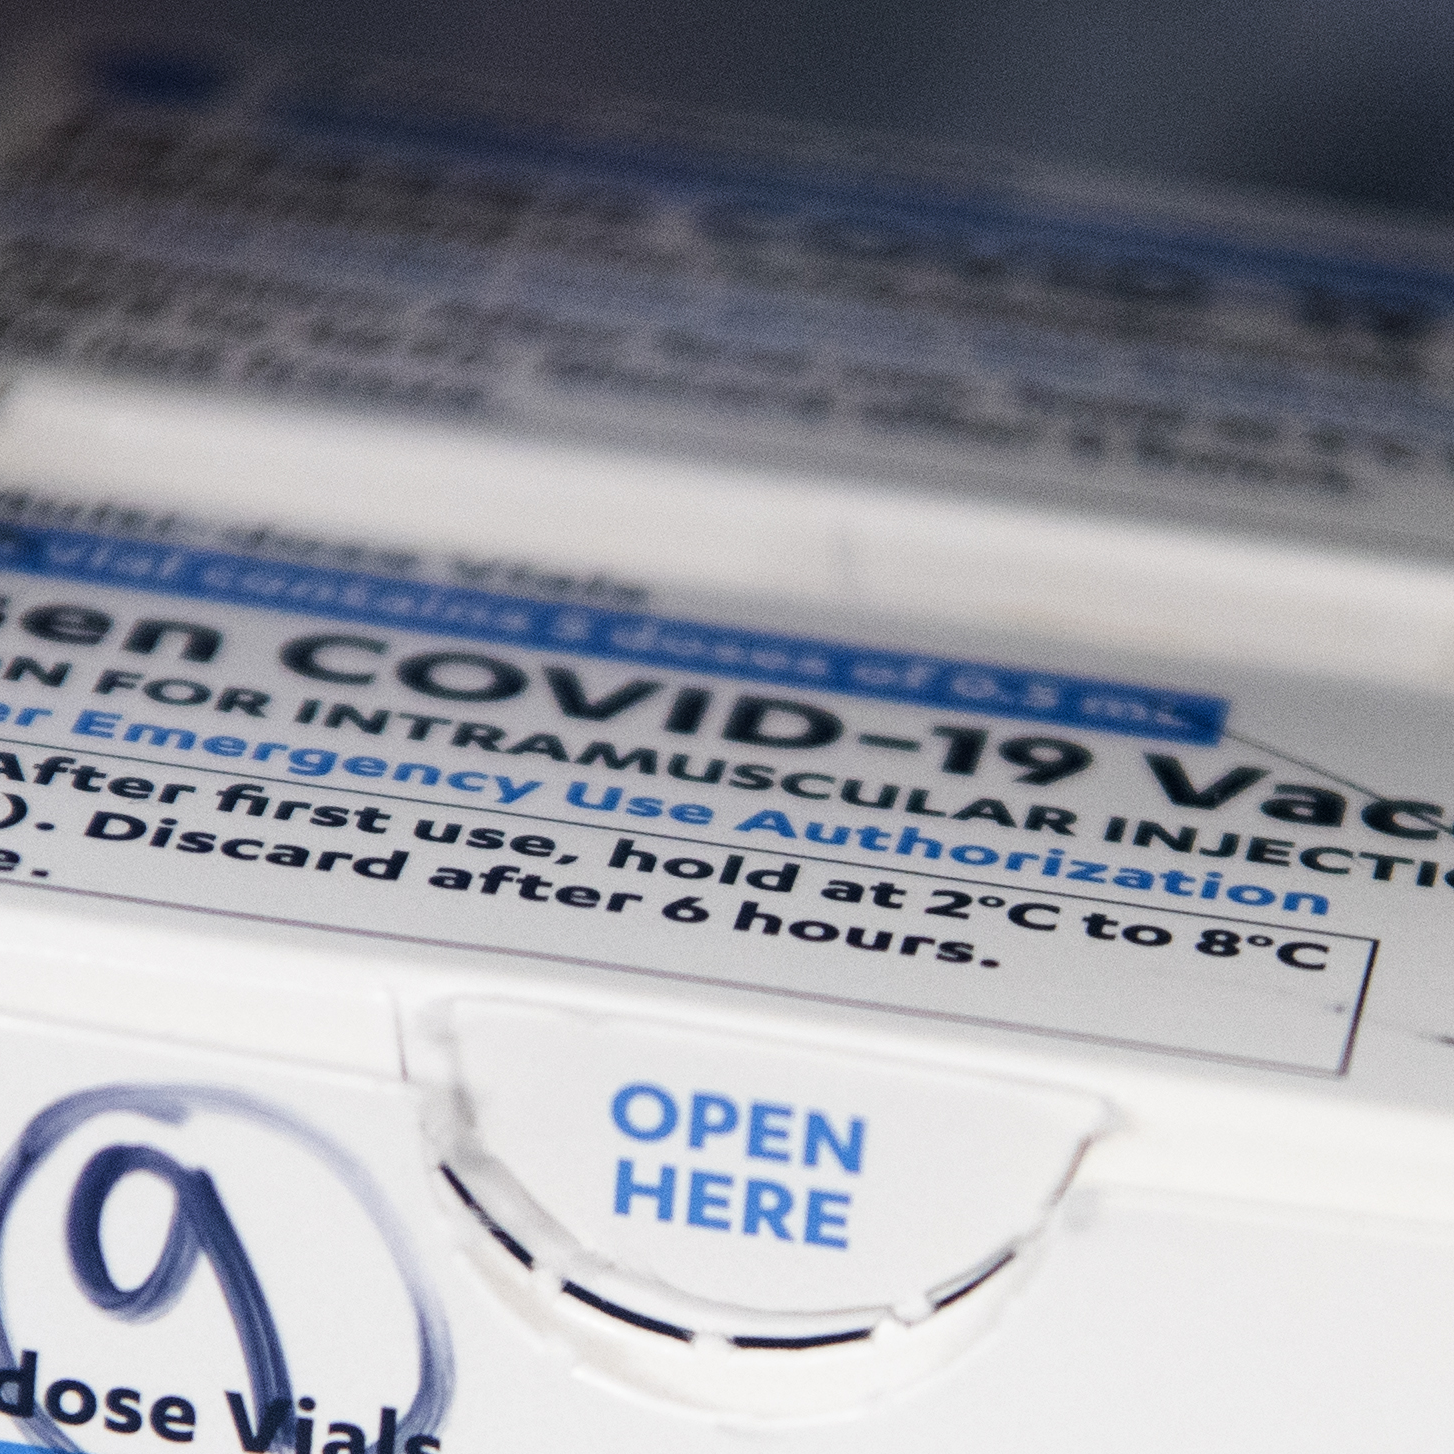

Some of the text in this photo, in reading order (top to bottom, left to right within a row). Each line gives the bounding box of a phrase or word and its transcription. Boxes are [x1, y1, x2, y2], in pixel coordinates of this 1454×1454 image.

[92, 669, 270, 722] FOR
[294, 695, 1077, 836] INTRAMUSCULAR
[281, 633, 1095, 788] COVID-19
[72, 708, 545, 805] Emergency
[565, 780, 715, 829] Use
[732, 808, 1334, 919] Authorization
[81, 808, 409, 886] Discard
[427, 866, 645, 916] after
[659, 892, 711, 925] 6
[731, 900, 1001, 969] hours.
[212, 783, 404, 837] first
[412, 815, 580, 866] use,
[606, 839, 802, 897] hold
[818, 869, 910, 911] at
[923, 890, 1065, 935] 2°C
[1079, 911, 1175, 951] to
[1193, 927, 1331, 972] 8°C
[608, 1080, 868, 1176] OPEN
[611, 1157, 854, 1251] HERE
